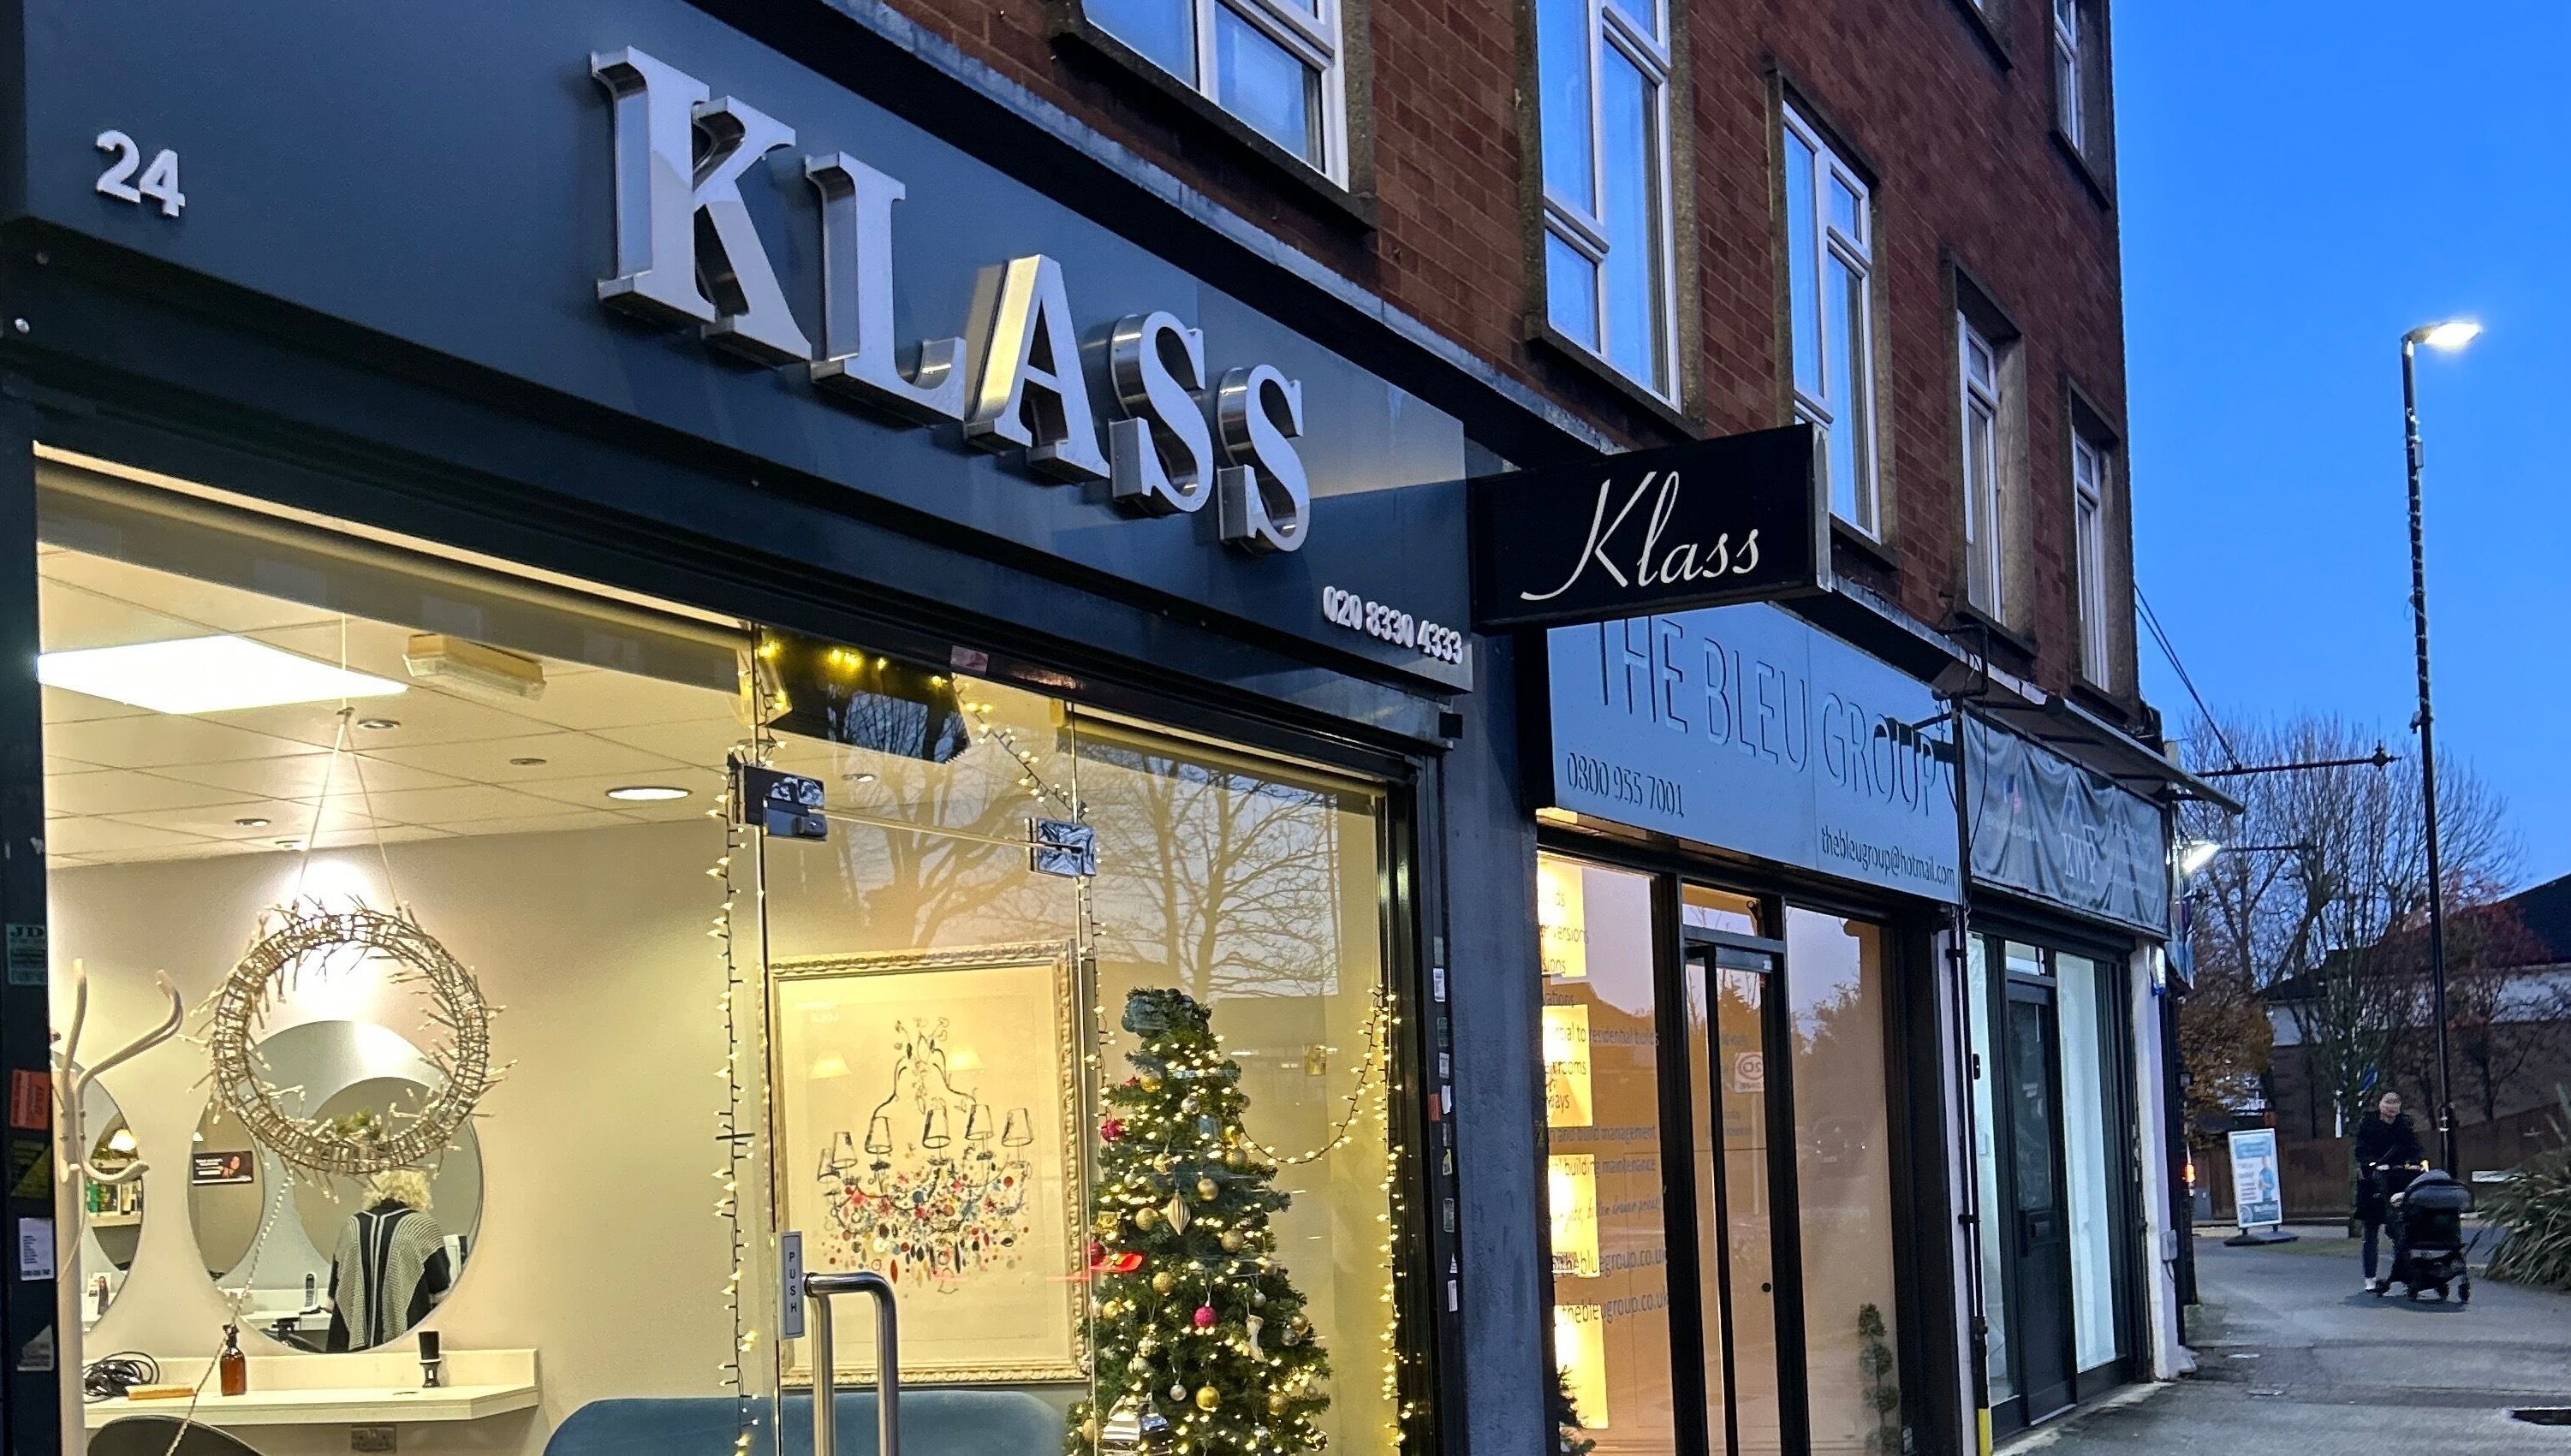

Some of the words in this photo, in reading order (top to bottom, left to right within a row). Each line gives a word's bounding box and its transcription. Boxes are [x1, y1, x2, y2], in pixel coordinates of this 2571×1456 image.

[96, 129, 186, 217] 24
[591, 45, 1312, 553] KLASS
[1520, 471, 1759, 601] Klass
[1323, 585, 1363, 631] 020
[1366, 601, 1414, 649] 8330
[1417, 620, 1464, 665] 4333
[1598, 615, 1687, 734] THE
[1704, 637, 1808, 773] BLEU
[1822, 692, 1937, 817] GROUP
[1567, 752, 1610, 798] 0800
[1613, 766, 1643, 806] 955
[1646, 776, 1685, 818] 7001
[1821, 824, 1955, 888] thebleugroup@hotmail.com
[789, 1251, 798, 1313] PUSH
